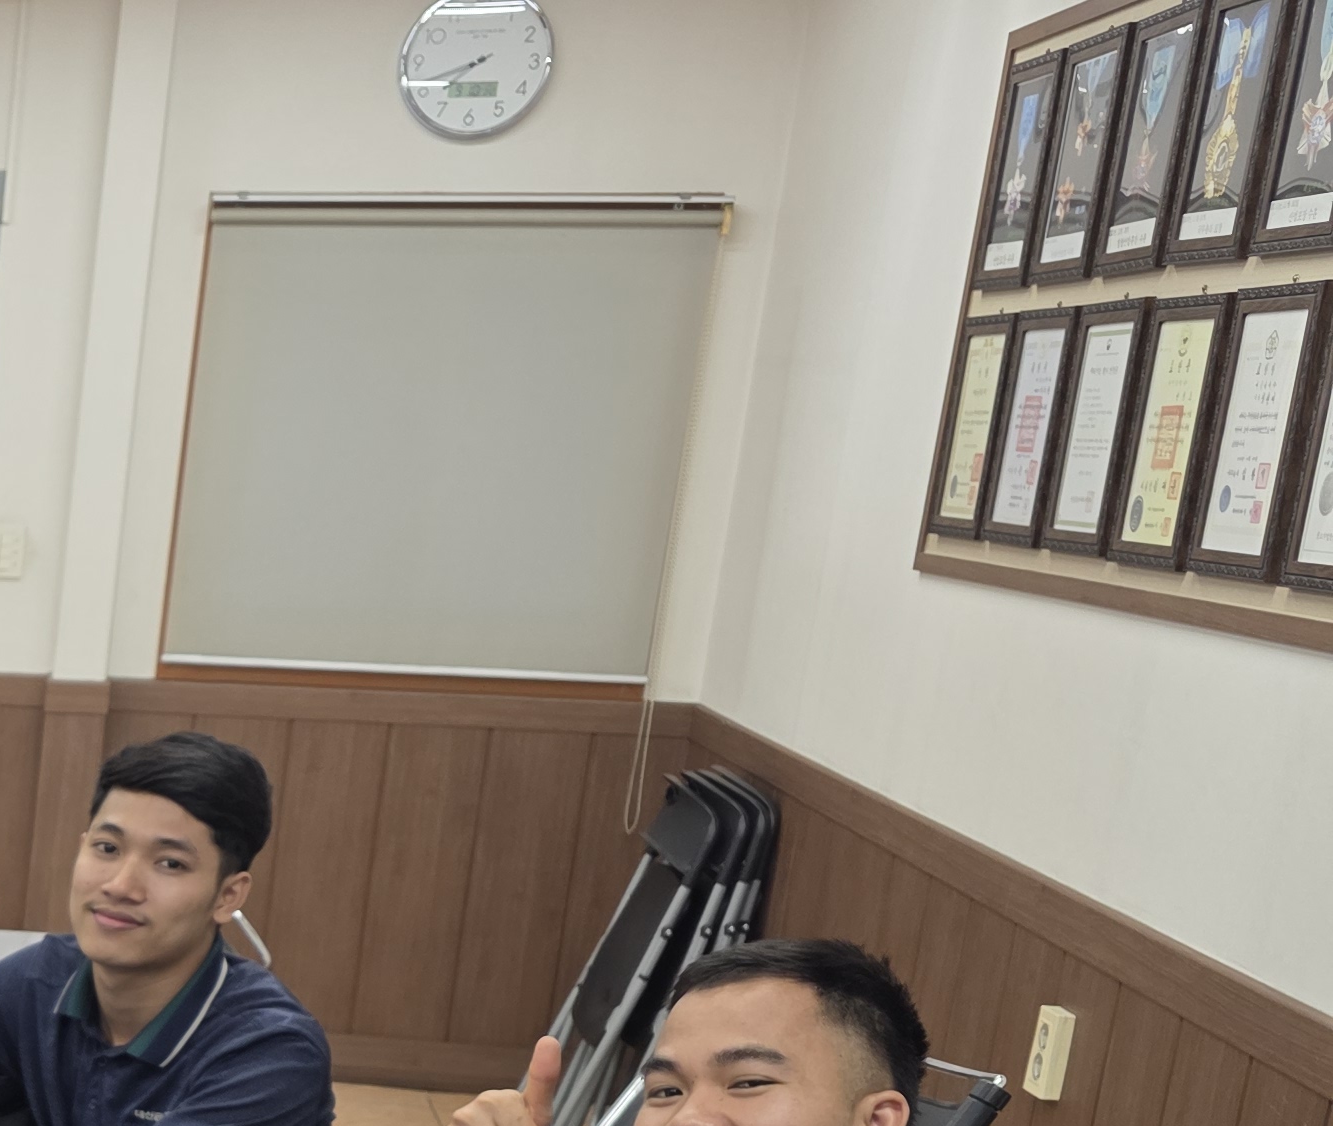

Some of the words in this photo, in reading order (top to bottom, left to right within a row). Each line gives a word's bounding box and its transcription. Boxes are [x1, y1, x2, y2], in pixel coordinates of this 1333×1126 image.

[426, 27, 447, 45] 10
[524, 25, 537, 43] 2
[413, 53, 425, 71] 9
[528, 52, 541, 70] 3
[515, 80, 527, 96] 4
[437, 101, 449, 118] 7
[463, 108, 475, 127] 6
[493, 100, 504, 117] 5
